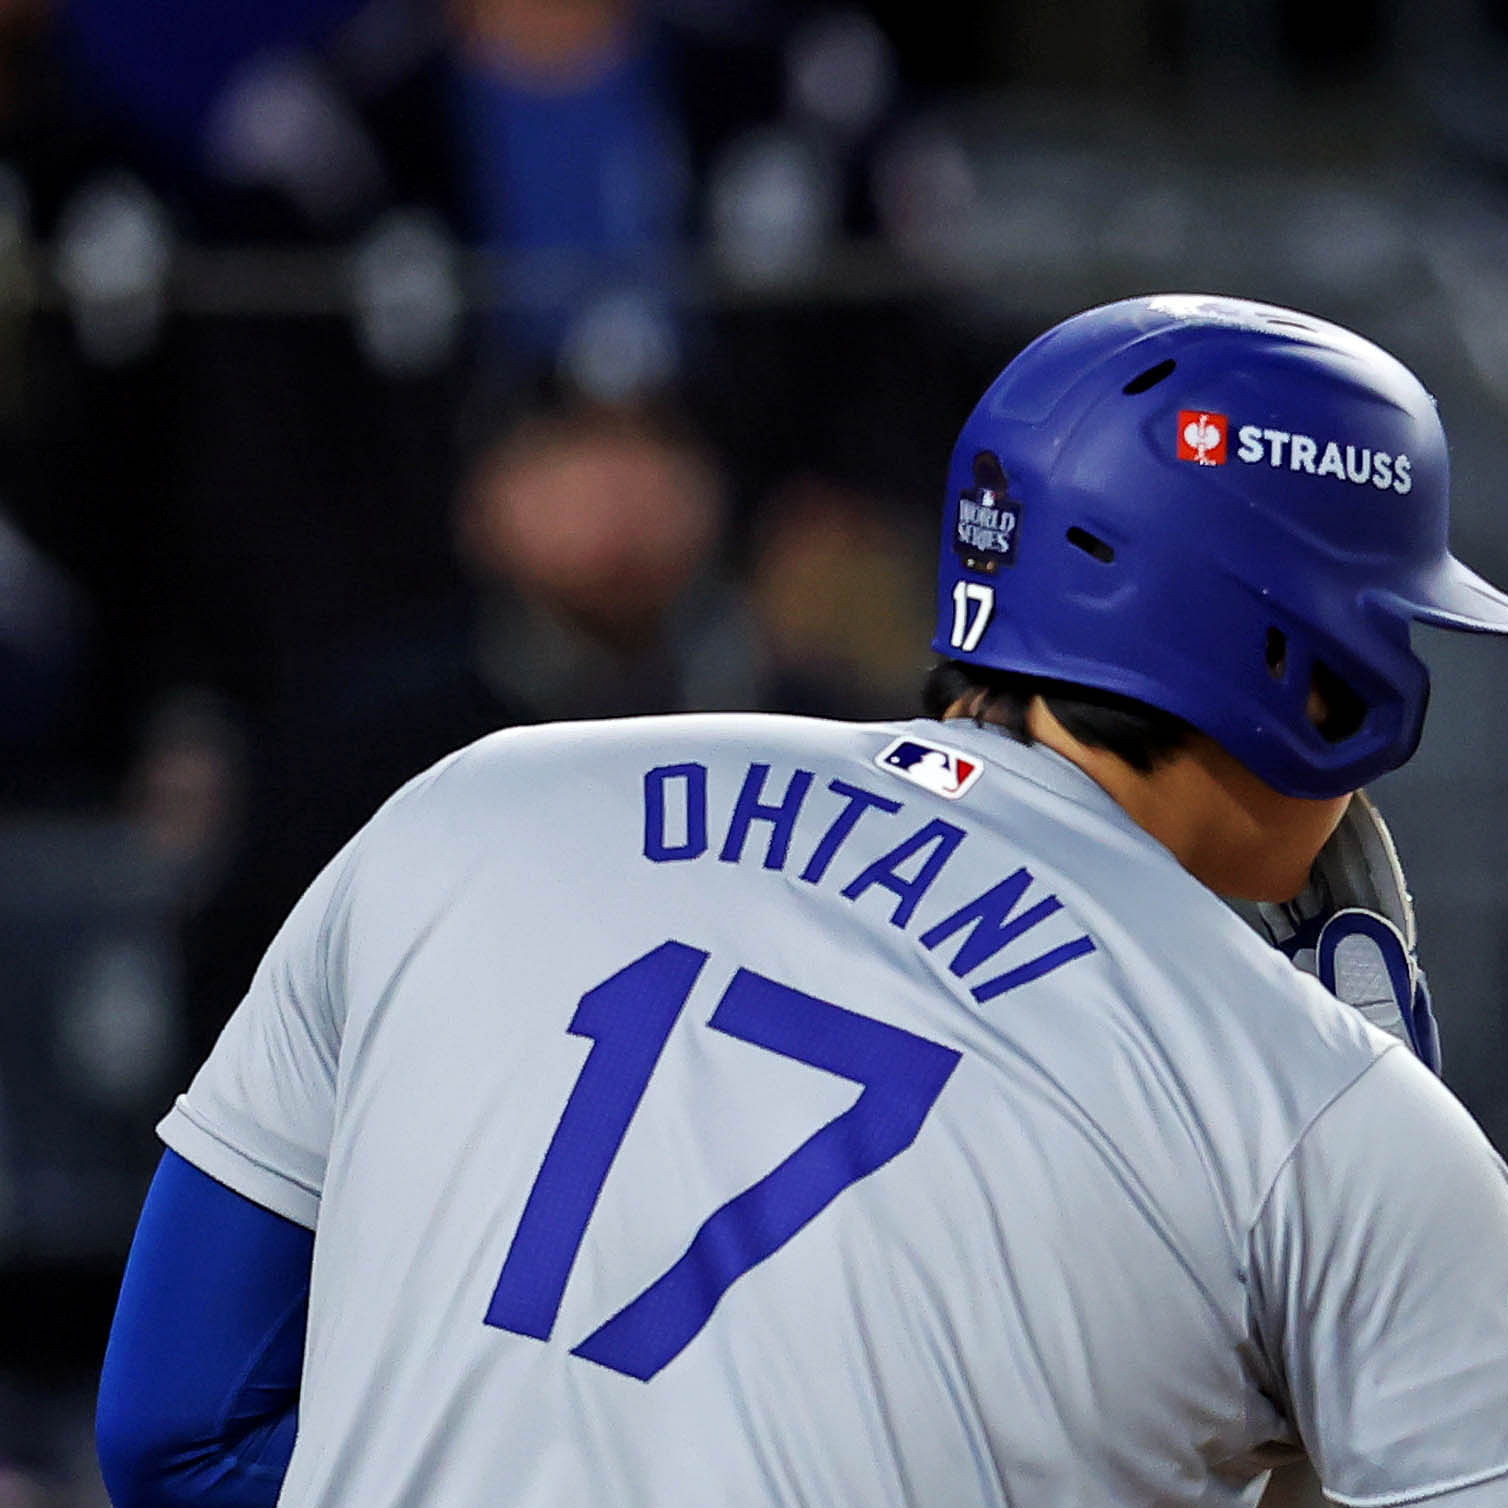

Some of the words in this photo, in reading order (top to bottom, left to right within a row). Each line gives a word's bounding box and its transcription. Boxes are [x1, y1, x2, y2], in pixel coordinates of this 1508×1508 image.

[1237, 424, 1413, 495] STRAUSS
[951, 580, 995, 652] 17
[643, 761, 1097, 1004] OHTANI
[483, 939, 964, 1383] 17
